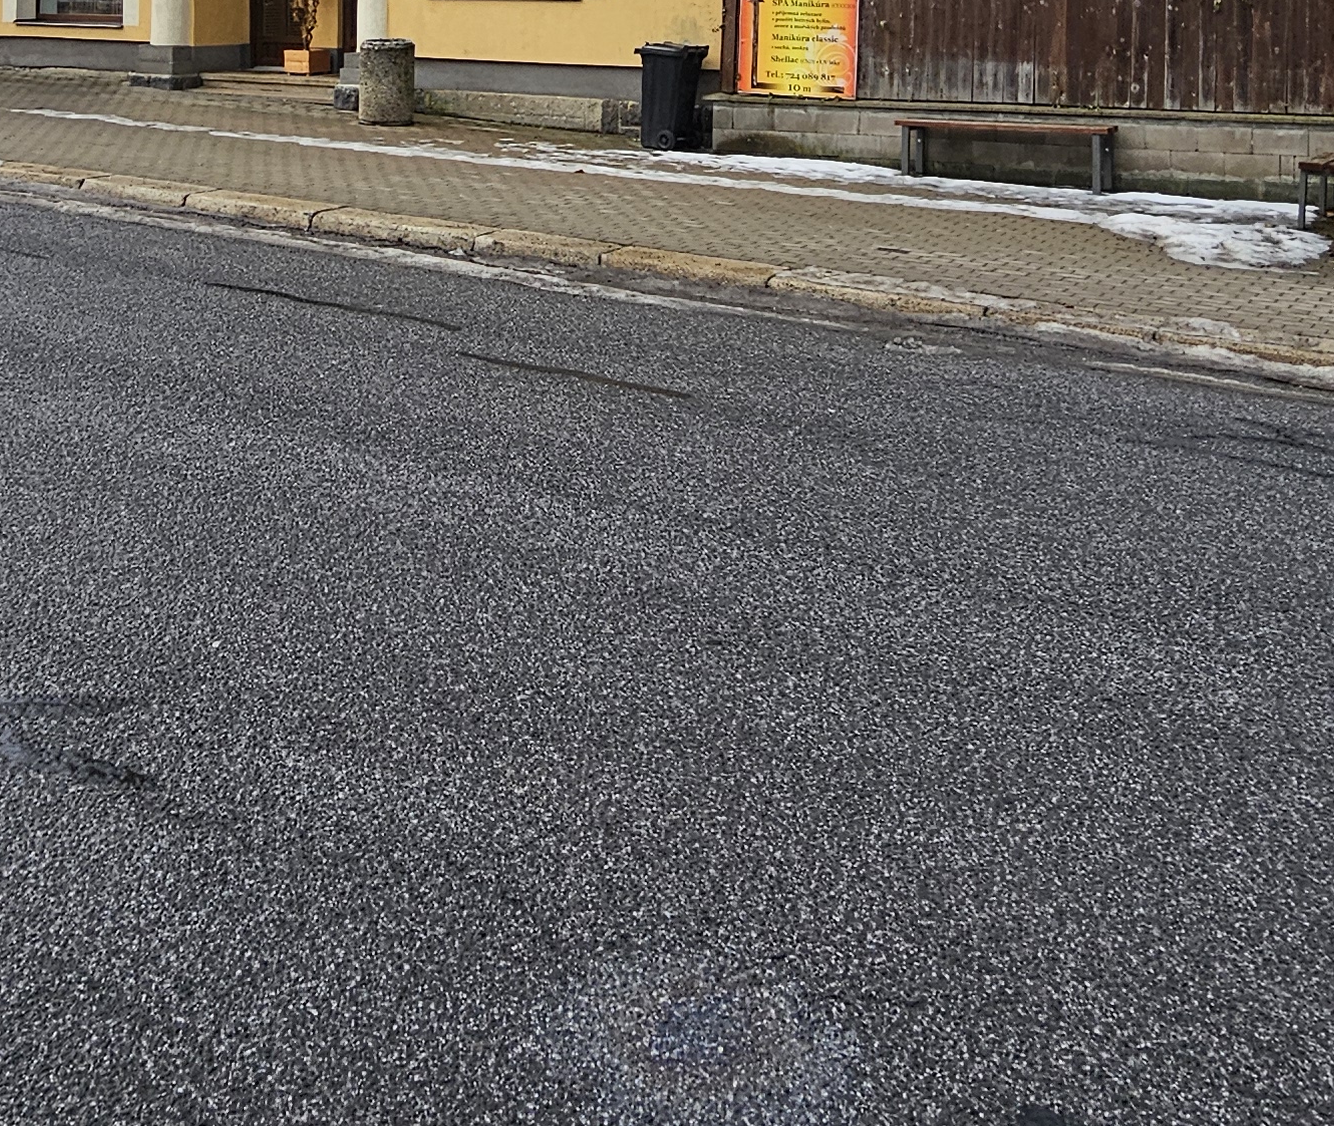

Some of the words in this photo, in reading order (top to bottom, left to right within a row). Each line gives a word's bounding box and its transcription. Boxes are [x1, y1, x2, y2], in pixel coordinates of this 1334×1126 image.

[791, 0, 830, 8] Manikúra
[812, 35, 839, 43] classic
[770, 55, 798, 63] Shellac
[765, 70, 784, 78] Tel.:
[785, 72, 800, 80] 724
[802, 72, 819, 80] 089
[820, 72, 836, 80] 817
